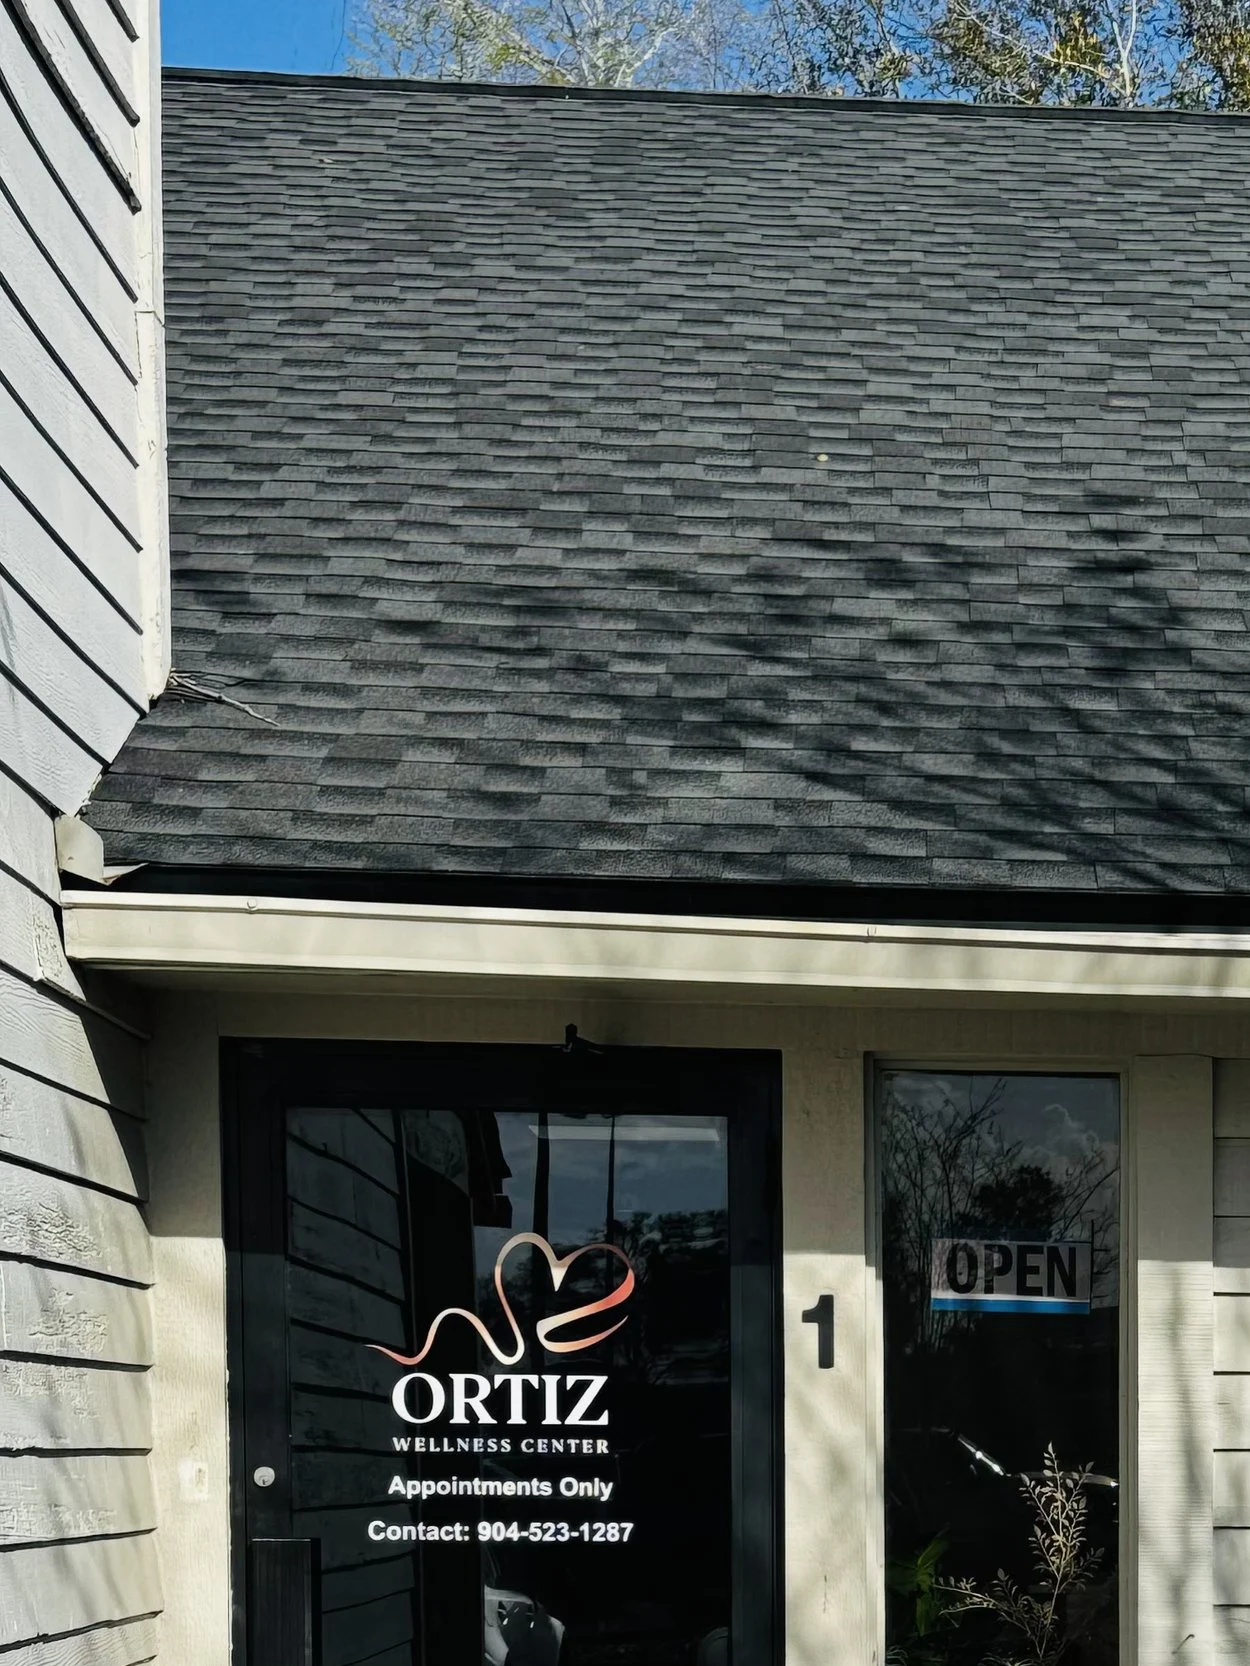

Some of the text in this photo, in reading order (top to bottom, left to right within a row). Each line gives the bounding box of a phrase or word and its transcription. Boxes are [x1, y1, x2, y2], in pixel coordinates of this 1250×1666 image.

[946, 1242, 1077, 1298] OPEN
[802, 1295, 834, 1369] 1
[391, 1373, 609, 1426] ORTIZ
[392, 1437, 610, 1455] WELLNESS CENTER
[388, 1476, 614, 1501] Appointments Only
[367, 1520, 634, 1543] Contact: 904-523-1287
